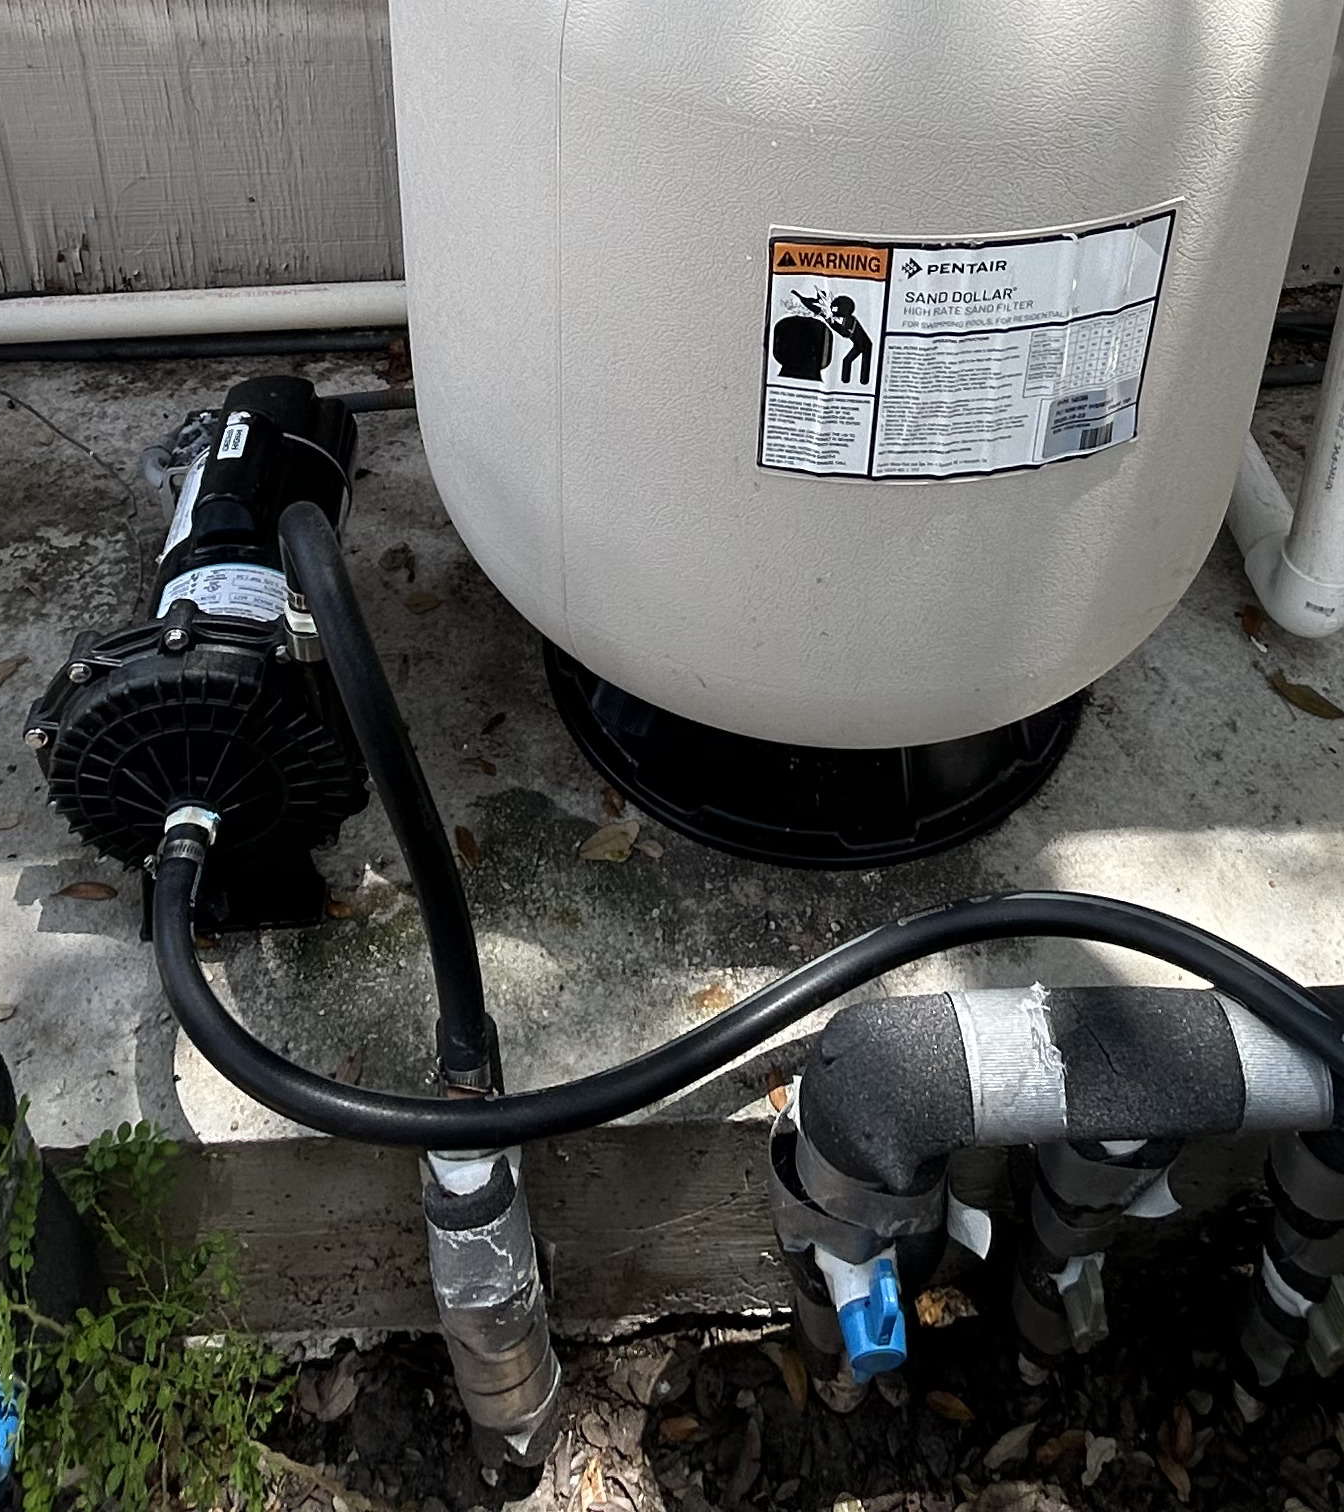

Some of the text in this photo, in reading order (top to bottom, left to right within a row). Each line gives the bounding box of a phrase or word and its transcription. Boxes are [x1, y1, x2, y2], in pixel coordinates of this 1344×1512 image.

[798, 252, 881, 273] WARNING
[927, 260, 1007, 275] PENTAIR
[905, 291, 948, 304] SAND
[903, 300, 1034, 316] HIGH RATE SAND FILTER
[902, 320, 919, 328] FOR
[995, 316, 1012, 325] FOR
[1013, 311, 1064, 322] RESIDENTIAL
